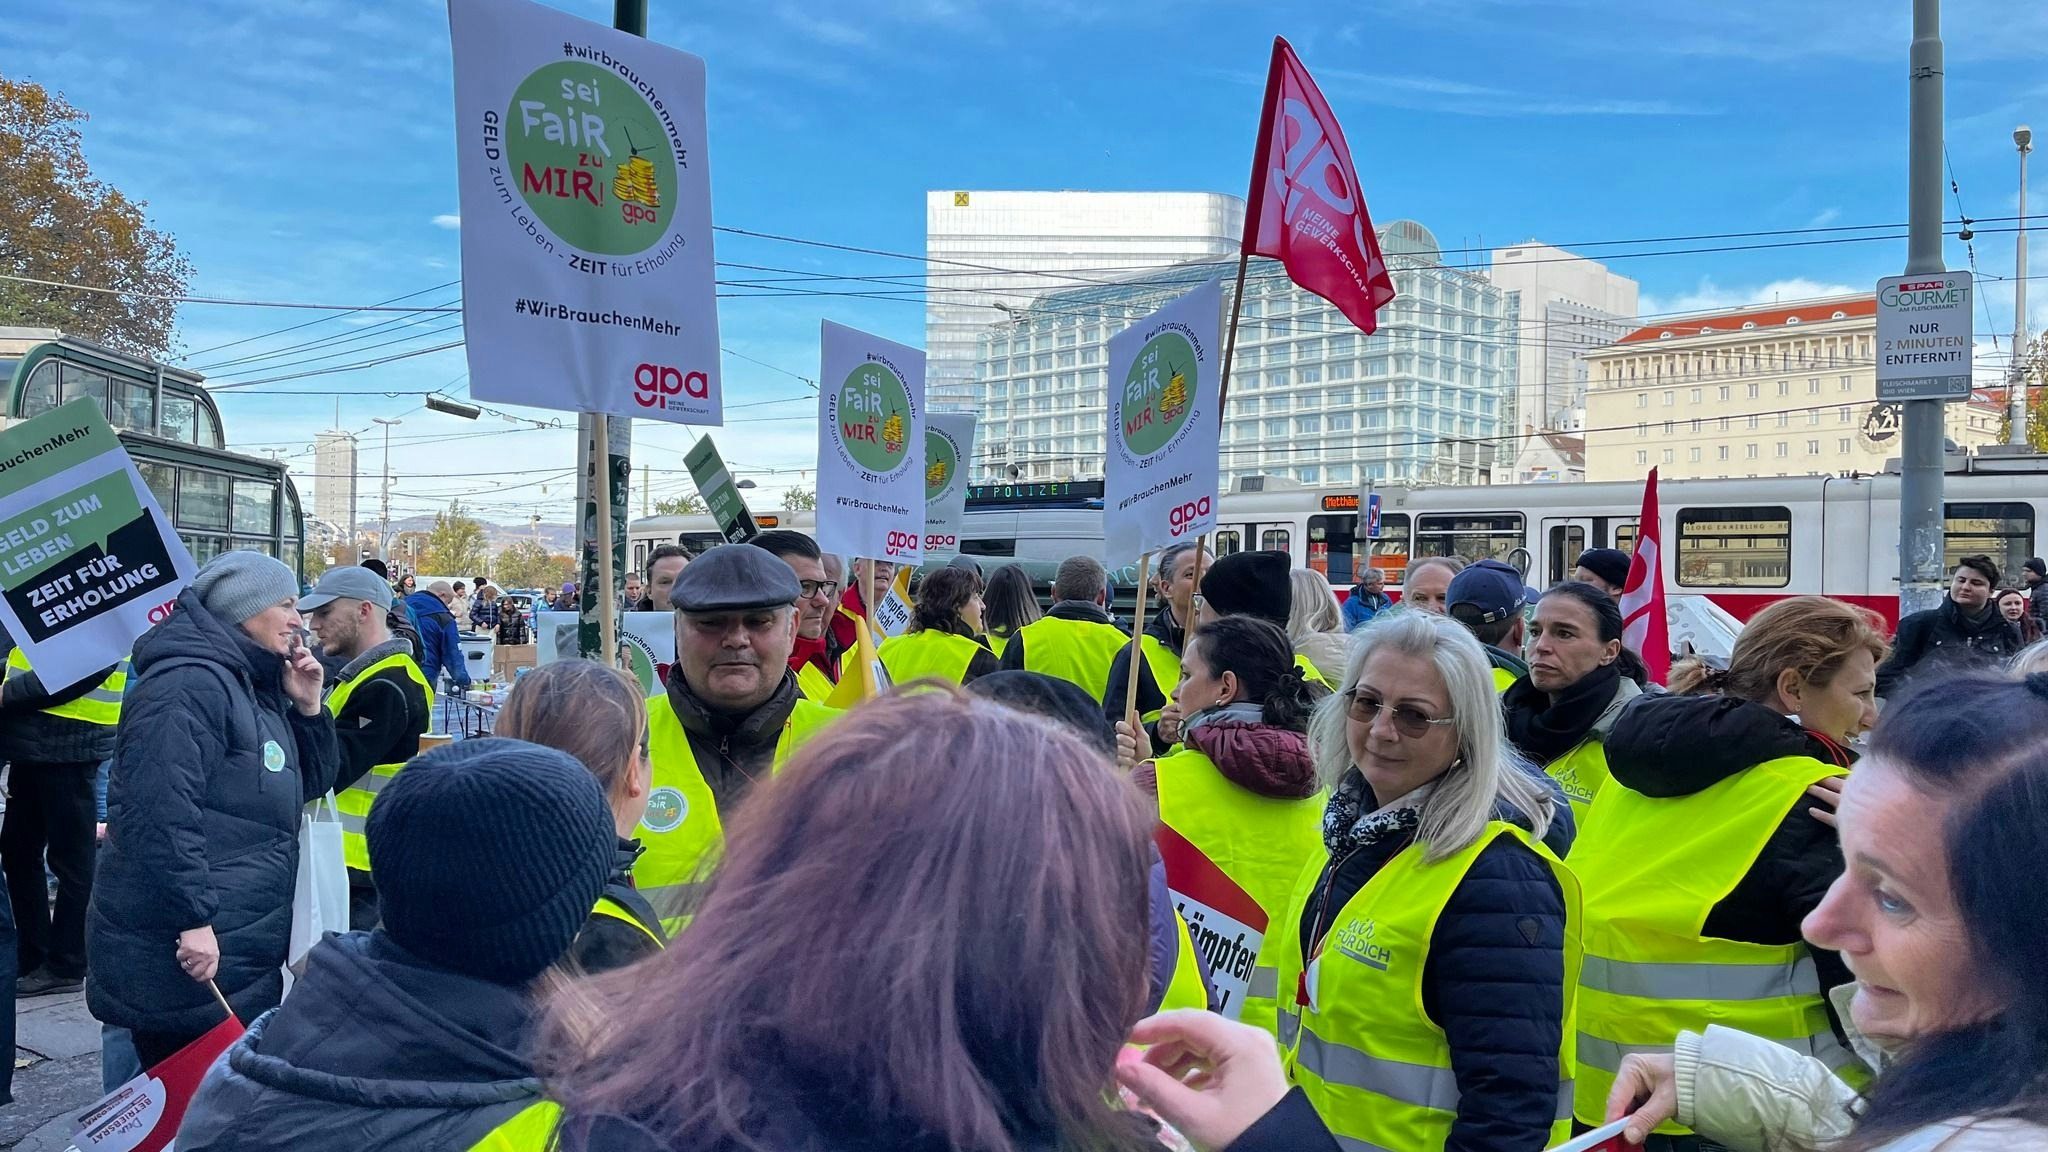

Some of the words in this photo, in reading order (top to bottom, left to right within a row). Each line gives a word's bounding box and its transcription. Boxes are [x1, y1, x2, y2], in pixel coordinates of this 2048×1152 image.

[561, 78, 600, 107] sei
[563, 42, 687, 169] #wirbrauchenmehr
[484, 110, 500, 161] GELD
[579, 153, 603, 168] zu
[490, 166, 511, 204] zum
[523, 162, 604, 207] MIR!
[511, 206, 554, 253] Leben
[622, 203, 656, 226] gpa
[1302, 207, 1340, 239] MEINE
[568, 254, 607, 275] ZEIT
[612, 262, 633, 277] für
[635, 232, 686, 276] Erholung
[1880, 284, 1969, 308] GOURMET
[1907, 281, 1944, 291] SPAR
[515, 298, 681, 337] #WirBrauchenMehr
[1911, 303, 1958, 312] FLEISCHMARKT
[1145, 322, 1204, 362] #wirbrauchenmehr
[1884, 340, 1892, 350] 2
[1897, 335, 1964, 350] MINUTEN
[1909, 322, 1939, 334] NUR
[1142, 345, 1158, 369] sei
[1886, 351, 1962, 365] ENTFERNT!
[634, 363, 708, 409] gpa
[863, 372, 880, 388] sei
[867, 352, 916, 419] #wirbrauchenmehr
[0, 424, 91, 473] auchenMehr
[829, 393, 837, 421] GELD
[837, 446, 855, 472] Leben
[861, 471, 877, 483] ZEIT
[889, 456, 913, 482] Erholung
[925, 425, 961, 462] irbrauchenmehr
[1139, 457, 1154, 469] ZEIT
[1168, 409, 1201, 454] Erholung
[836, 496, 909, 516] #WirBrauchenMehr
[994, 484, 1069, 498] POLIZEI
[1119, 473, 1193, 511] #WirBrauchenMehr
[0, 517, 50, 552] GELD
[51, 494, 103, 528] ZUM
[1169, 495, 1211, 537] gpa
[2, 533, 75, 576] LEBEN
[886, 531, 918, 556] gpa
[925, 535, 955, 550] gpa
[26, 574, 74, 609] ZEIT
[75, 554, 123, 587] FÜR
[40, 563, 160, 628] ERHOLUNG
[885, 591, 908, 624] ämpfen
[622, 631, 658, 672] auchenmehr
[1565, 784, 1594, 799] DICH
[1356, 939, 1391, 963] DICH
[92, 1097, 152, 1144] BETRIEBSRAT
